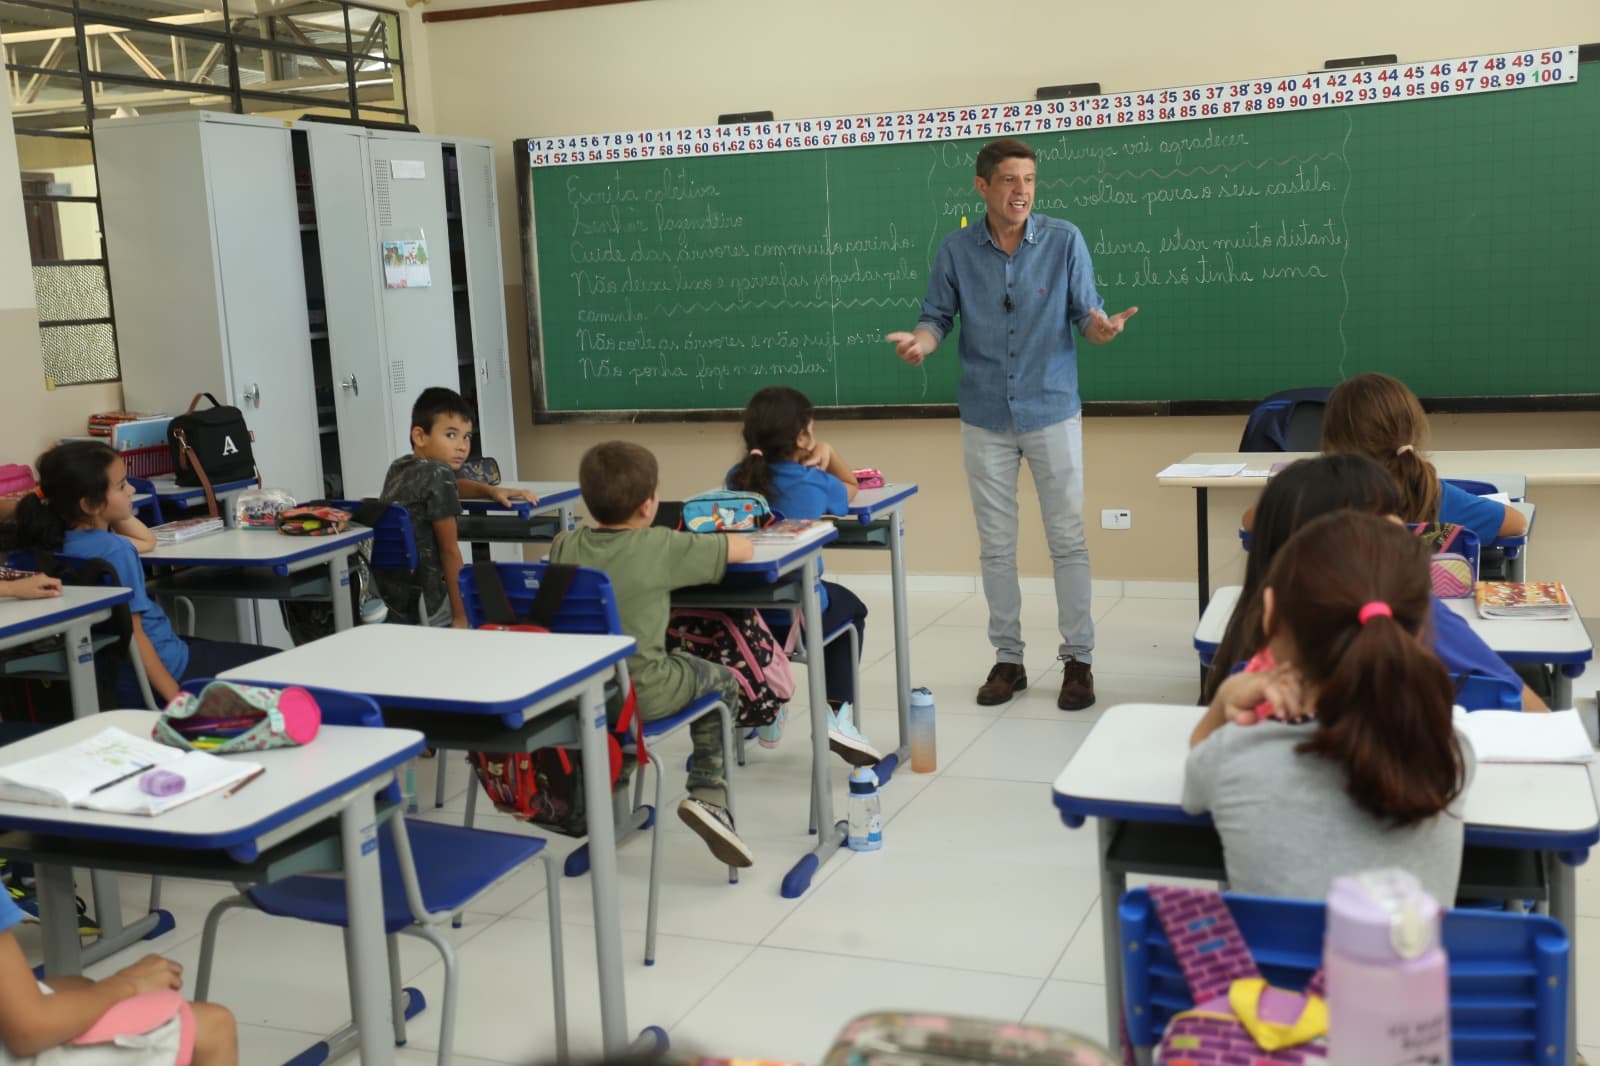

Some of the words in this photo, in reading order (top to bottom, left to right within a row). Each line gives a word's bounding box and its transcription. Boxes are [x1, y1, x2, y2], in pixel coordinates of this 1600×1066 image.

[546, 140, 554, 150] 2
[558, 139, 565, 149] 3
[569, 138, 576, 148] 4
[580, 137, 588, 147] 5
[591, 137, 599, 147] 6
[602, 136, 610, 146] 7
[614, 135, 622, 145] 8
[626, 134, 634, 144] 9
[638, 133, 652, 143] 10
[658, 132, 672, 142] 11
[677, 131, 692, 141] 12
[696, 129, 711, 139] 13
[716, 128, 731, 138] 14
[735, 126, 750, 137] 15
[755, 125, 771, 135] 16
[775, 124, 790, 134] 17
[796, 122, 811, 132] 18
[816, 121, 832, 131] 19
[836, 119, 852, 130] 20
[856, 118, 871, 128] 21
[876, 116, 893, 127] 22
[897, 114, 913, 125] 23
[918, 113, 934, 123] 24
[939, 111, 955, 122] 25
[960, 109, 977, 120] 26
[981, 107, 998, 118] 27
[1003, 106, 1020, 117] 28
[1025, 104, 1042, 115] 29
[1047, 102, 1064, 113] 30
[1069, 100, 1086, 111] 31
[1092, 98, 1109, 109] 32
[1114, 96, 1132, 107] 33
[1137, 94, 1154, 105] 34
[1159, 92, 1177, 103] 35
[1182, 89, 1200, 101] 36
[1206, 87, 1224, 99] 37
[1230, 85, 1248, 97] 38
[1254, 82, 1272, 94] 39
[1277, 80, 1297, 92] 40
[1302, 77, 1320, 90] 41
[1327, 75, 1347, 87] 42
[1352, 72, 1372, 85] 43
[1378, 69, 1398, 82] 44
[1404, 66, 1424, 79] 45
[1430, 63, 1451, 76] 46
[1457, 60, 1478, 73] 47
[1484, 57, 1506, 70] 48
[1512, 54, 1534, 67] 49
[1540, 50, 1562, 64] 50
[536, 153, 549, 164] 51
[554, 152, 568, 162] 52
[571, 151, 585, 161] 53
[589, 150, 602, 160] 54
[606, 149, 620, 159] 55
[624, 148, 637, 158] 56
[641, 147, 655, 157] 57
[659, 145, 673, 156] 58
[677, 144, 691, 155] 59
[694, 143, 709, 154] 60
[712, 142, 726, 152] 61
[730, 141, 745, 151] 62
[748, 140, 764, 150] 63
[767, 139, 782, 149] 64
[786, 137, 800, 147] 65
[804, 136, 819, 146] 66
[822, 135, 838, 145] 67
[841, 133, 856, 144] 68
[860, 132, 876, 142] 69
[879, 131, 894, 141] 70
[898, 129, 912, 140] 71
[918, 128, 932, 138] 72
[937, 126, 952, 137] 73
[956, 125, 972, 135] 74
[976, 123, 991, 134] 75
[995, 122, 1011, 132] 76
[1015, 120, 1031, 131] 77
[1036, 118, 1051, 129] 78
[1056, 117, 1072, 127] 79
[1076, 115, 1092, 126] 80
[1096, 113, 1112, 124] 81
[1117, 111, 1134, 122] 82
[1138, 110, 1154, 121] 83
[1159, 108, 1176, 119] 84
[1180, 106, 1197, 117] 85
[1202, 104, 1218, 115] 86
[1223, 102, 1240, 113] 87
[1245, 100, 1262, 111] 88
[1267, 97, 1285, 109] 89
[1289, 95, 1308, 107] 90
[1312, 93, 1329, 105] 91
[1335, 91, 1354, 103] 92
[1358, 88, 1377, 101] 93
[1382, 86, 1401, 99] 94
[1406, 83, 1425, 96] 95
[1430, 81, 1450, 94] 96
[1455, 78, 1474, 91] 97
[1480, 75, 1499, 89] 98
[1505, 72, 1525, 86] 99
[1532, 69, 1562, 83] 100
[1122, 136, 1152, 155] vai
[1159, 127, 1249, 167] agradecer
[1142, 186, 1198, 216] para
[570, 239, 626, 263] Cuide
[1159, 224, 1209, 253] estar
[1213, 221, 1272, 249] muito
[1132, 256, 1162, 287] ele
[1165, 267, 1189, 286] só
[1195, 251, 1254, 284] tinha
[1262, 265, 1328, 279] uma
[576, 327, 615, 351] Não
[578, 357, 622, 379] Não
[222, 435, 239, 456] A
